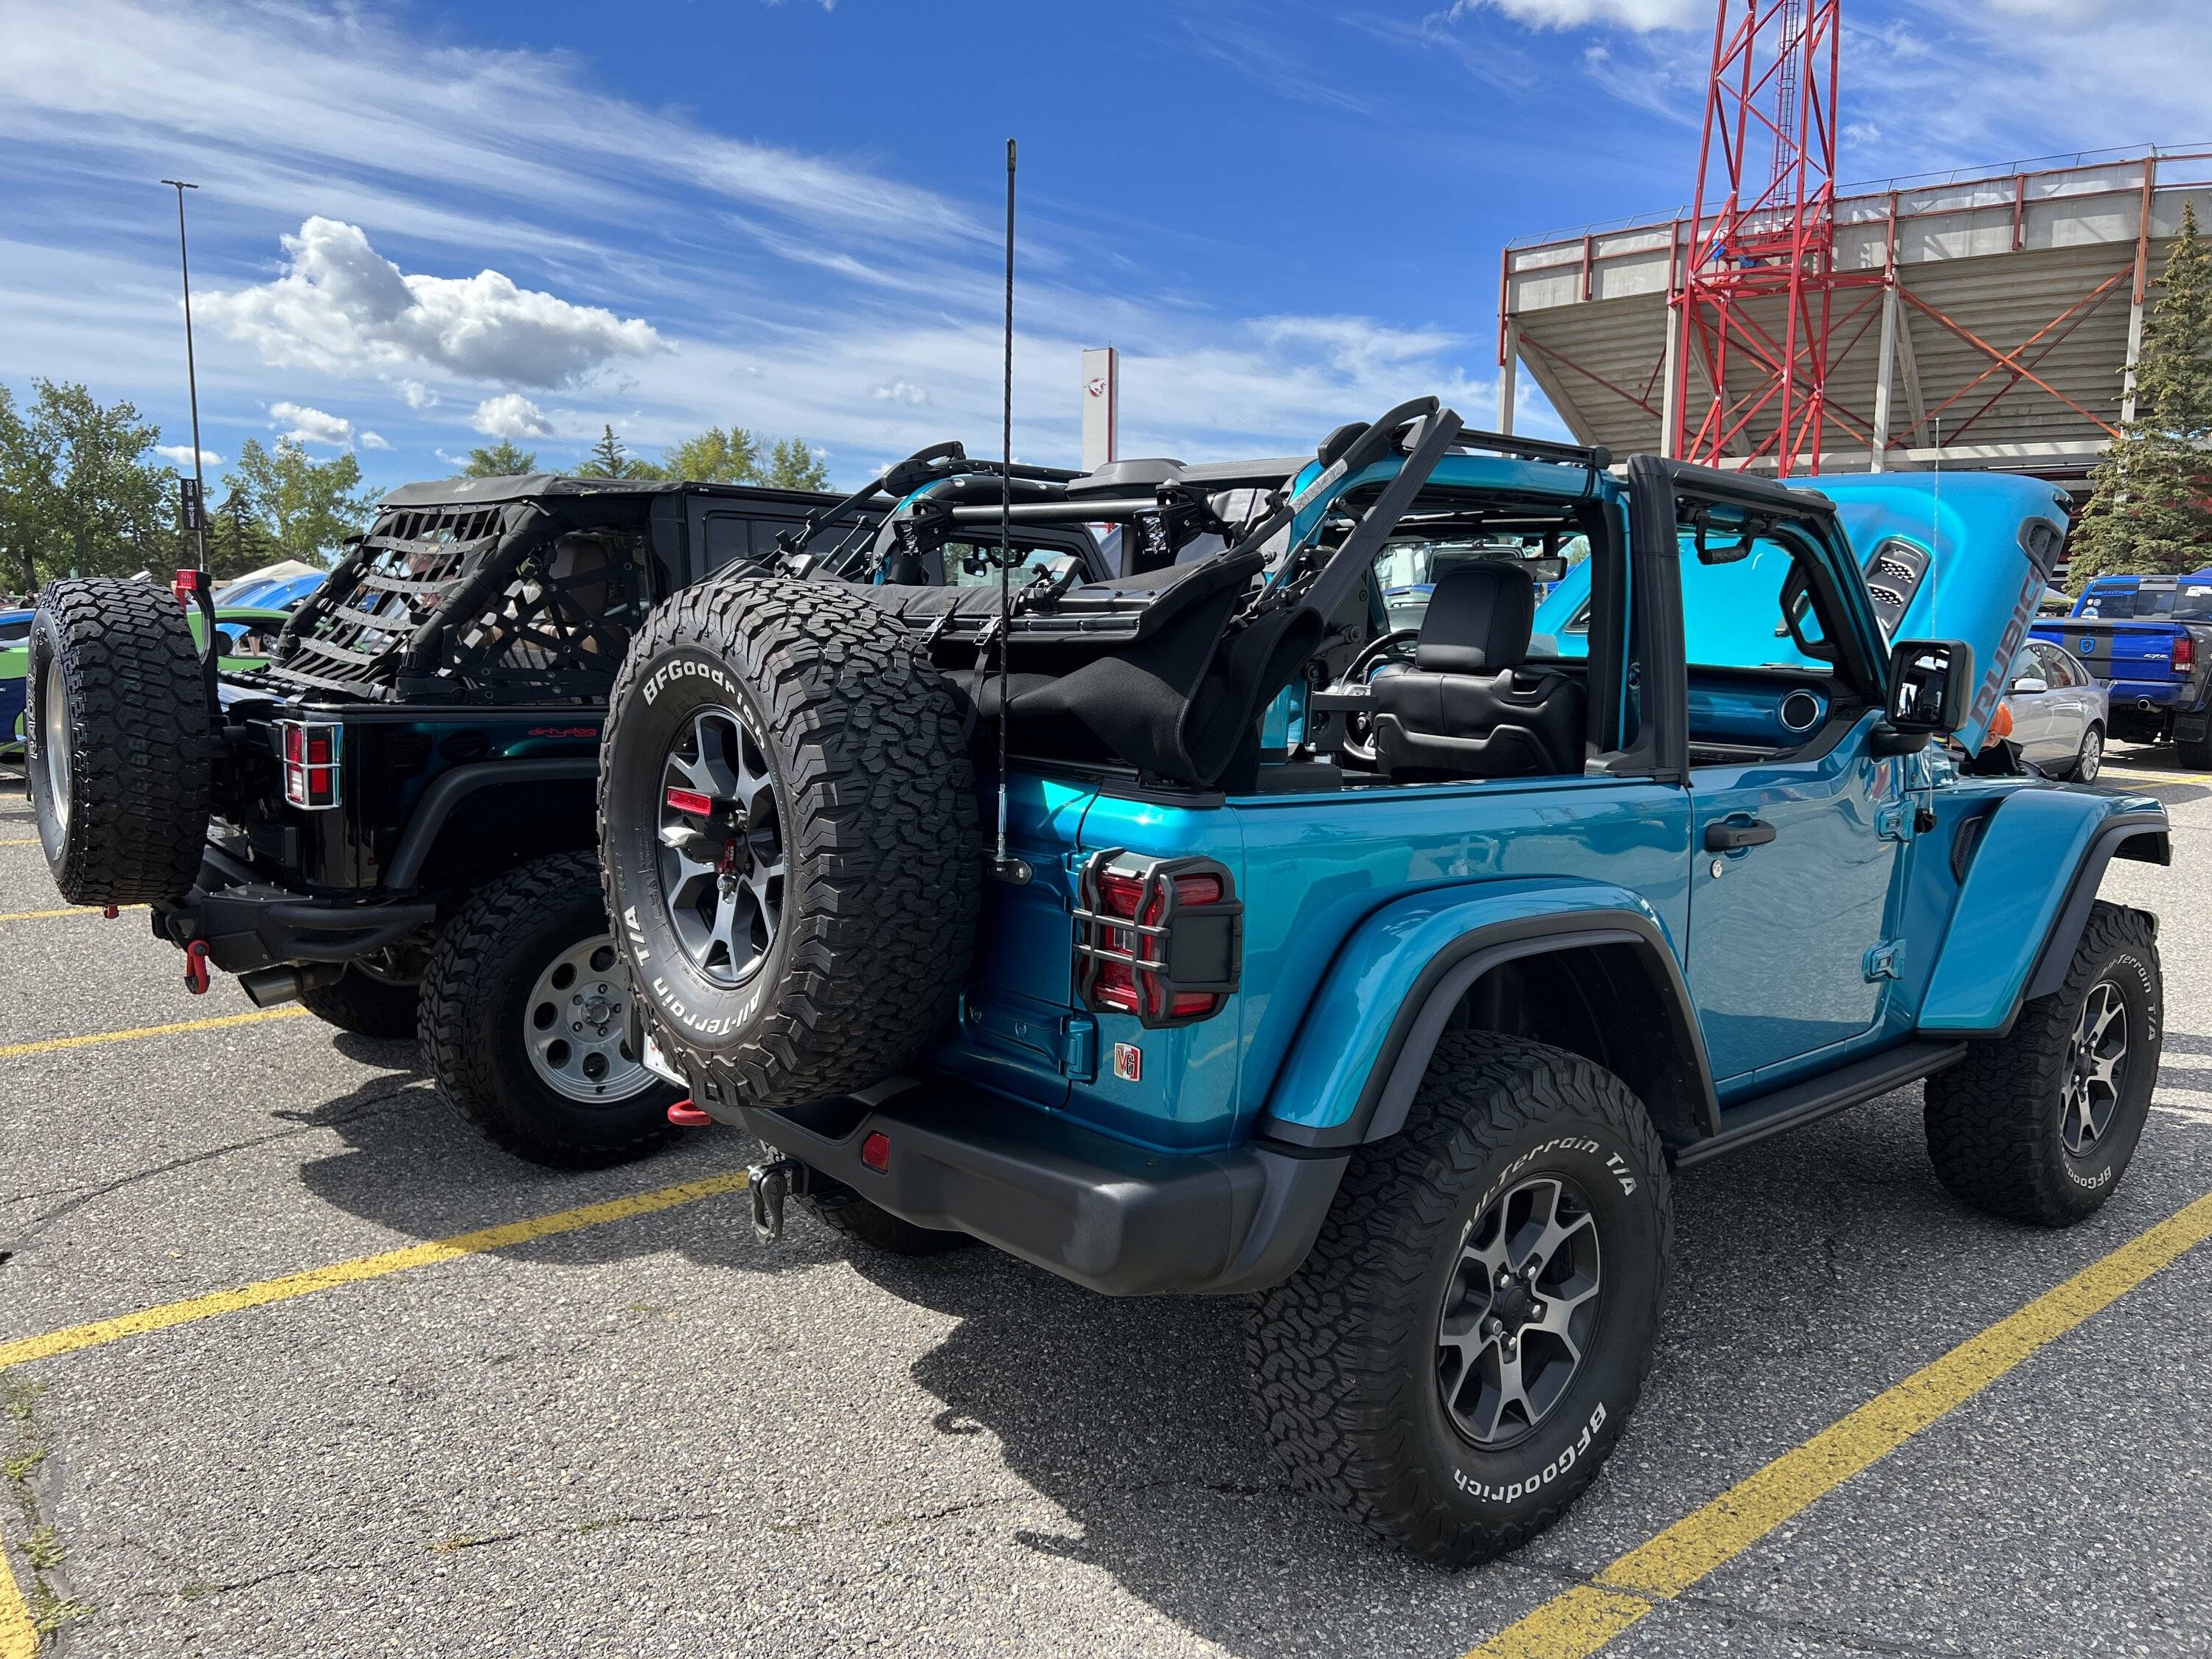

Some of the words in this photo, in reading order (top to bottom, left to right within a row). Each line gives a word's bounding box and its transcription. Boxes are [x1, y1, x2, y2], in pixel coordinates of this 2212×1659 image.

[27, 664, 38, 759] RADIAL
[642, 659, 765, 750] BFGoodrich
[624, 905, 651, 967] T/A
[653, 976, 762, 1037] All-Terrain
[2147, 1001, 2157, 1041] T/A
[1116, 1048, 1135, 1077] V6
[2059, 1125, 2112, 1190] BFGood
[1458, 1135, 1600, 1250] All-Terrain
[1605, 1151, 1638, 1197] T/A
[1453, 1401, 1607, 1504] BFGoodrich
